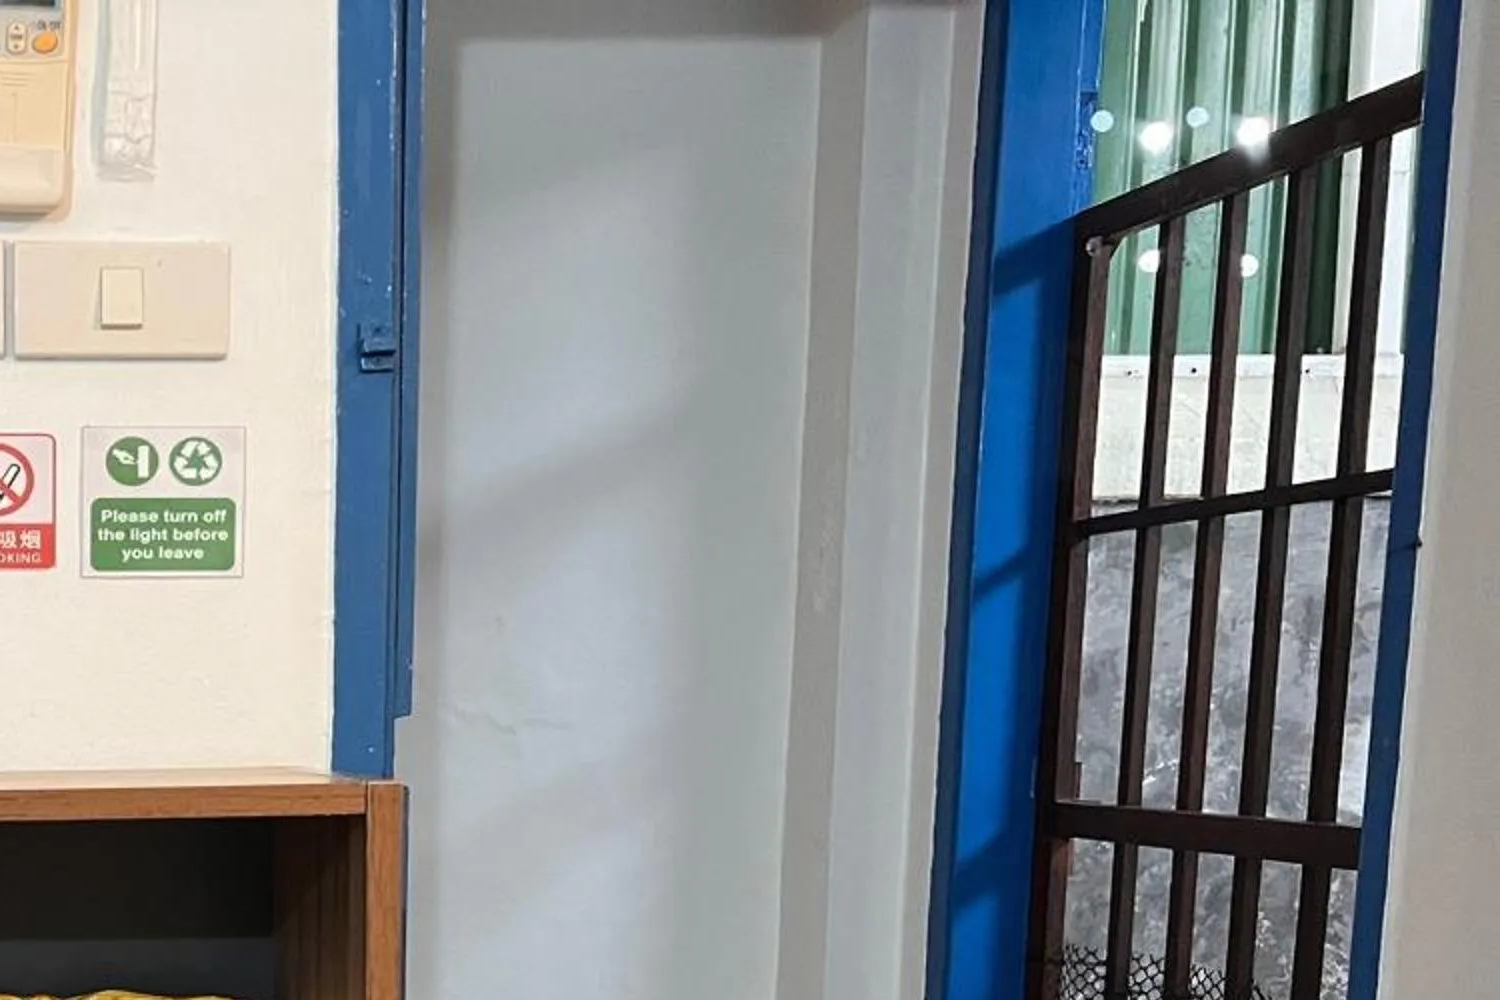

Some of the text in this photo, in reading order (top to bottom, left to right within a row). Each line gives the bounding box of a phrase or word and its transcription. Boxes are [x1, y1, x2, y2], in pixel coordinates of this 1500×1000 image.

[101, 509, 227, 523] Please turn off
[98, 527, 229, 545] the light before
[121, 546, 205, 563] you leave
